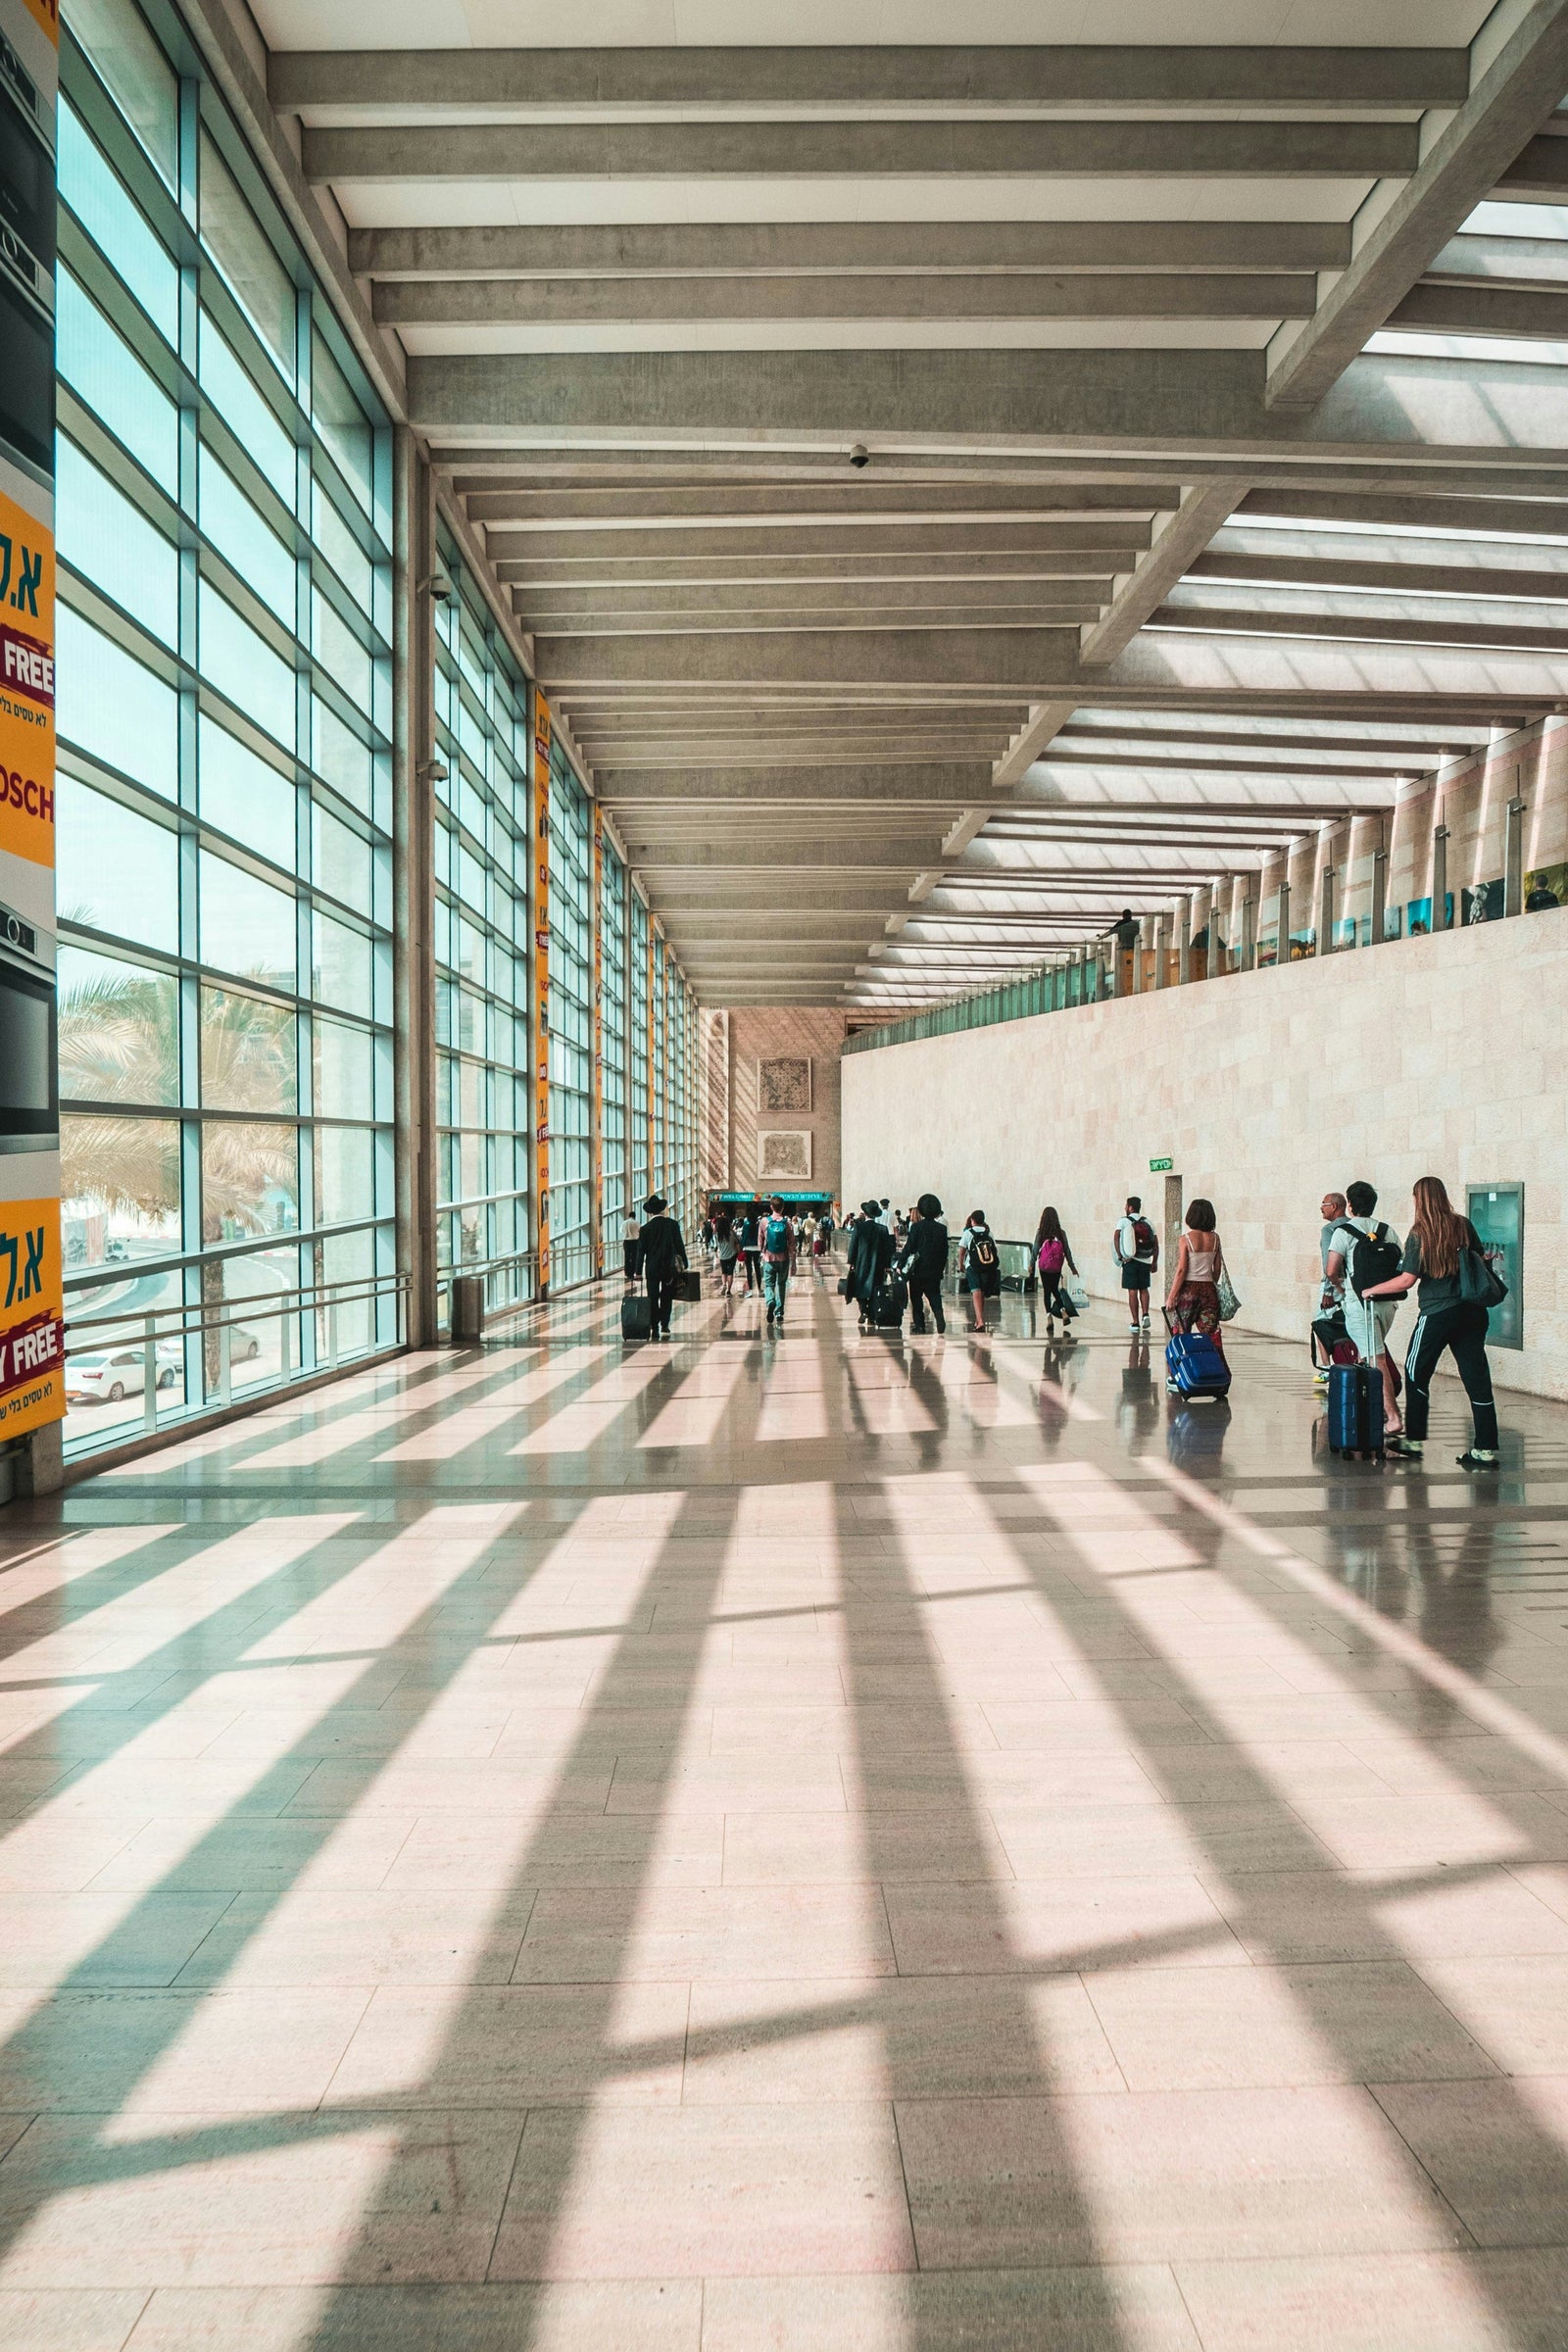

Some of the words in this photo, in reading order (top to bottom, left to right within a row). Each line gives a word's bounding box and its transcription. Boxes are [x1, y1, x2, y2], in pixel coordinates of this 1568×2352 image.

[4, 639, 55, 695] FREE
[13, 1321, 58, 1375] FREE
[23, 1388, 42, 1408] טסים
[43, 1381, 53, 1397] לא
